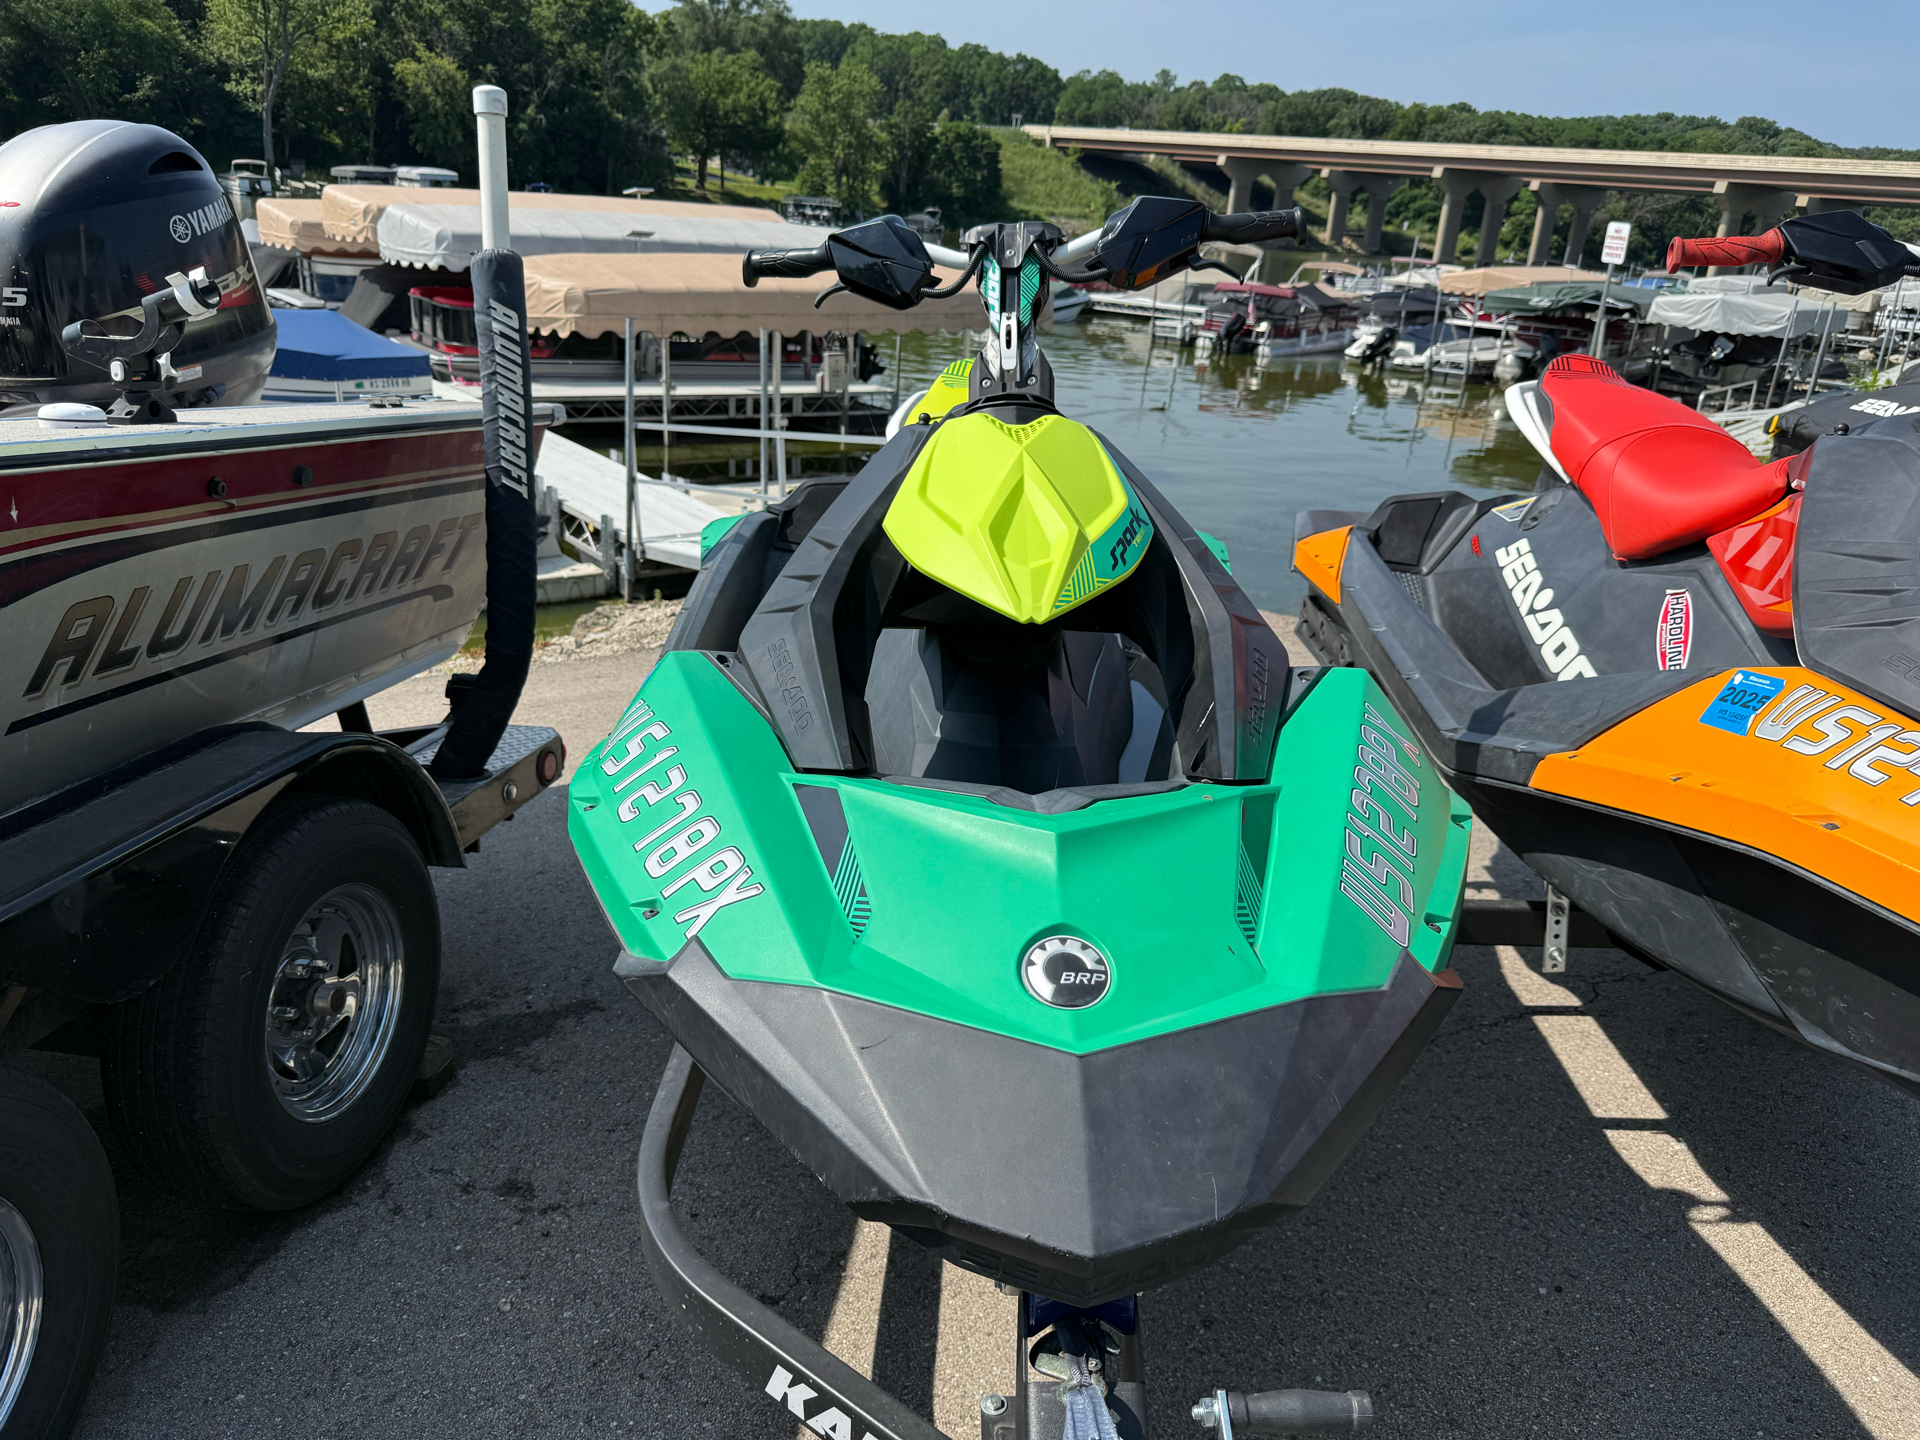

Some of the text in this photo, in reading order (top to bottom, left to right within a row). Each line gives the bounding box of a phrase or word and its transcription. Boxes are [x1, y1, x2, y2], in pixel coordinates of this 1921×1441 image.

[187, 195, 233, 236] YAMAHA
[490, 298, 529, 500] ALUMACRAFT
[22, 512, 484, 700] ALUMACRAFT
[1668, 595, 1686, 670] HARDLINE
[1718, 686, 1772, 712] 2025
[1748, 675, 1771, 685] Wisconsin
[599, 698, 765, 940] WS1278PX
[1339, 701, 1421, 948] WS1278PX
[1060, 971, 1106, 985] BRP
[764, 1364, 880, 1440] KA
